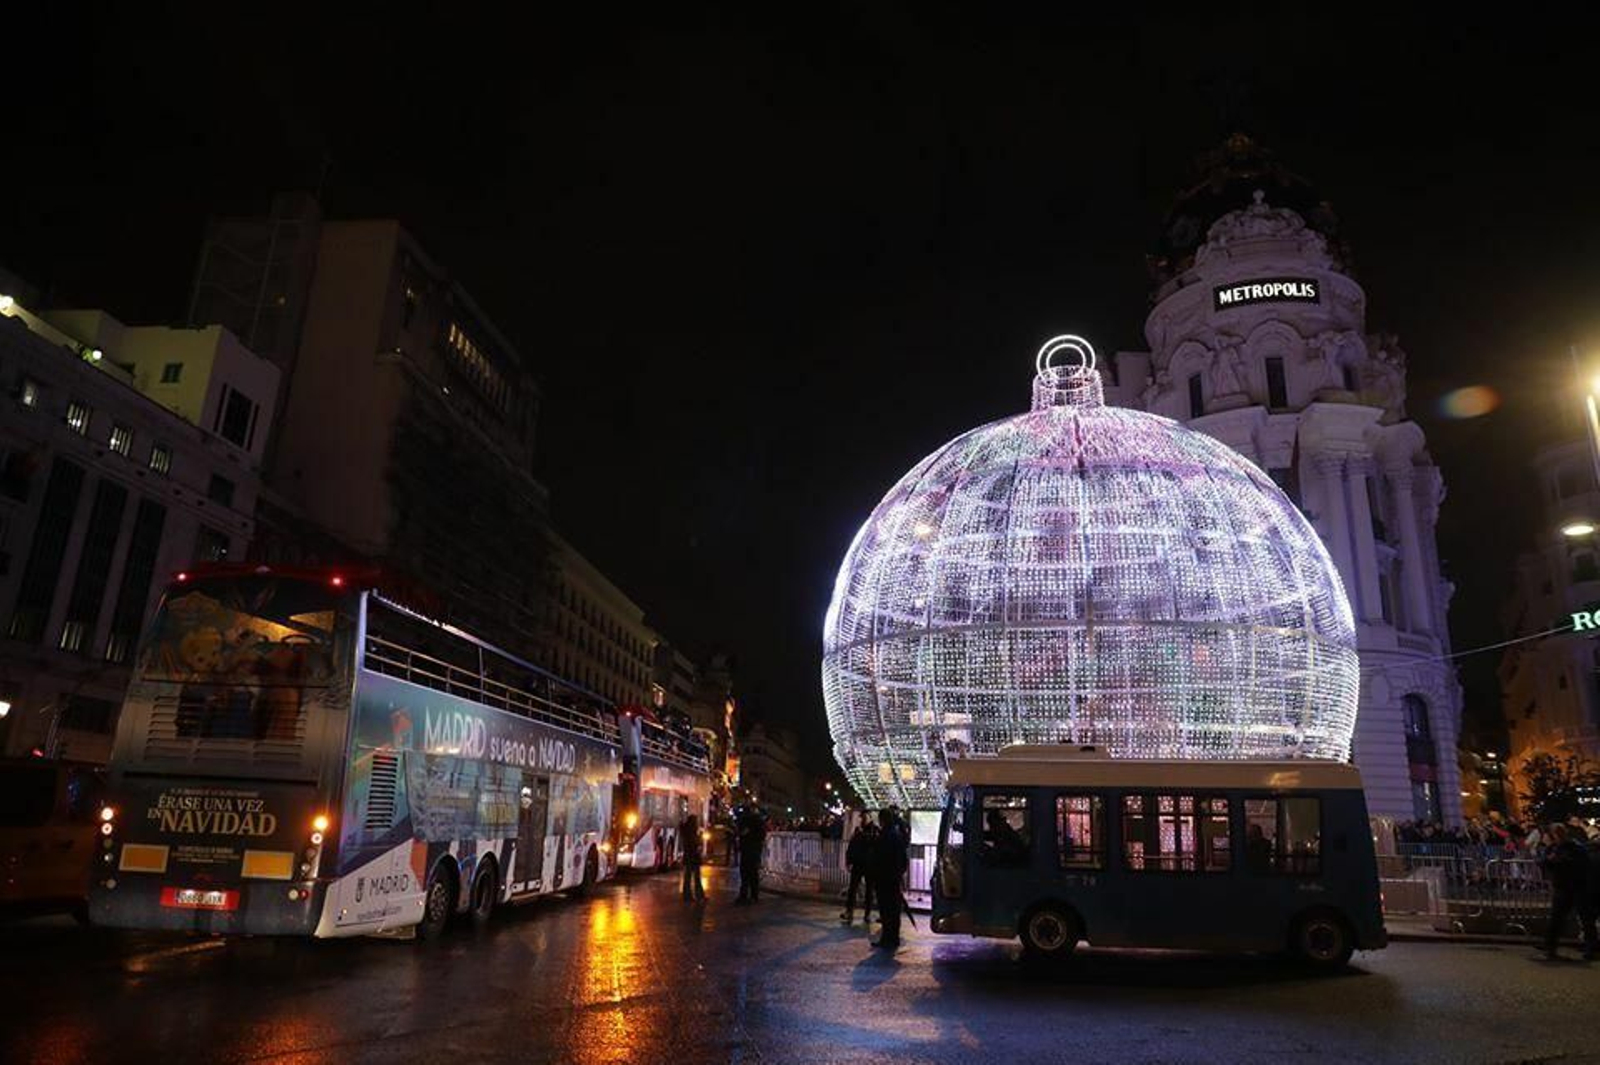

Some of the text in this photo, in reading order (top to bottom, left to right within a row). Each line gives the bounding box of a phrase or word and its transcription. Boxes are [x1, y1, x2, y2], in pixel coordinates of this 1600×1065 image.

[1218, 282, 1316, 305] METROPOLIS
[424, 706, 487, 758] MADRID
[539, 736, 576, 774] NAVIDAD
[204, 797, 233, 812] UNA
[237, 799, 264, 813] VEZ
[160, 808, 276, 836] NAVIDAD
[369, 874, 409, 897] MADRID
